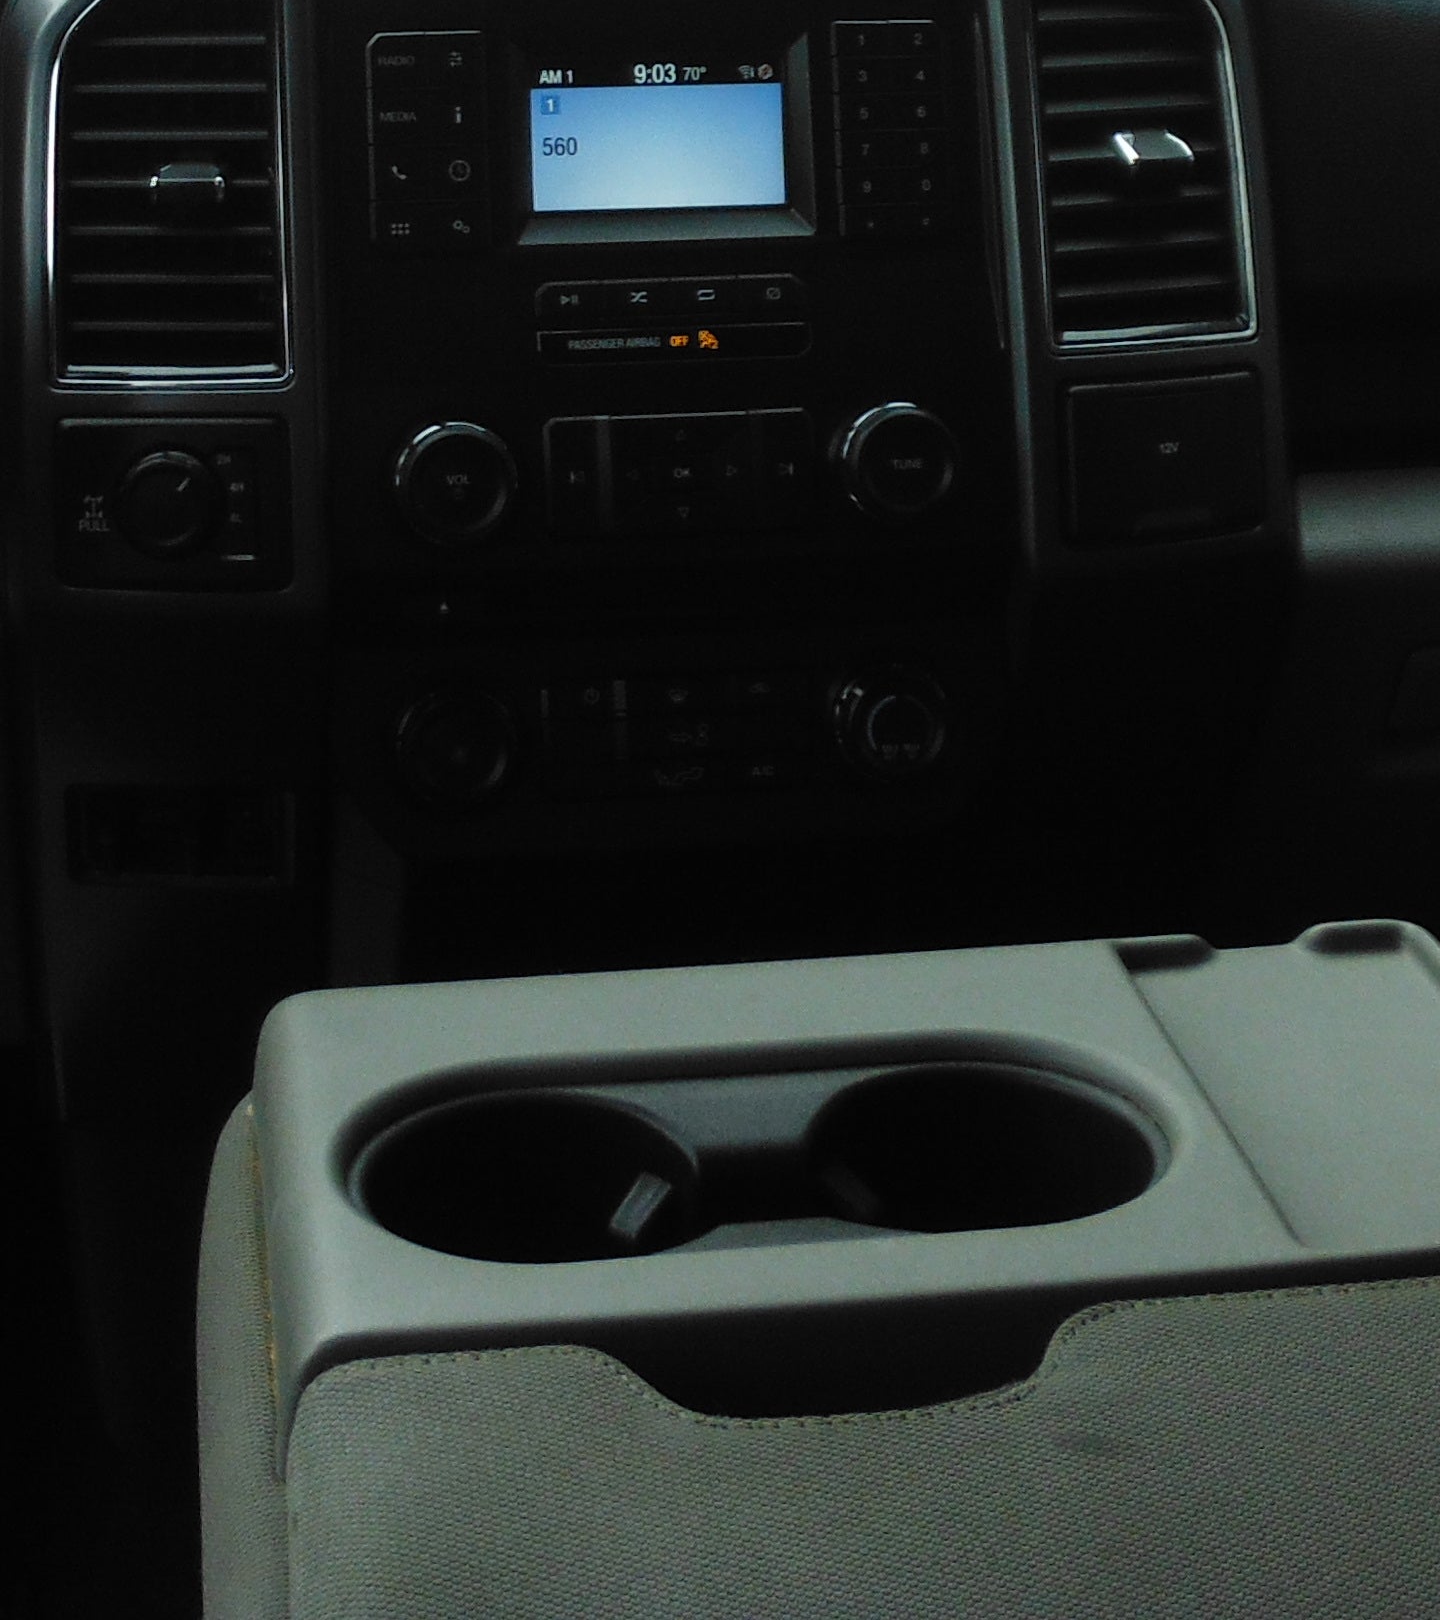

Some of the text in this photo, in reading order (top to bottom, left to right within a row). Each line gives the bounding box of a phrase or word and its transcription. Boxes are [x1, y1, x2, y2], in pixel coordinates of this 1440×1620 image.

[378, 55, 416, 67] RADIO
[539, 69, 575, 84] AM 1
[632, 63, 678, 84] 9:03
[380, 111, 417, 123] MEDIA
[542, 137, 578, 156] 560
[568, 334, 690, 351] PASSENGER AIRBAG OFF
[445, 473, 472, 486] VOL
[672, 467, 691, 479] OK
